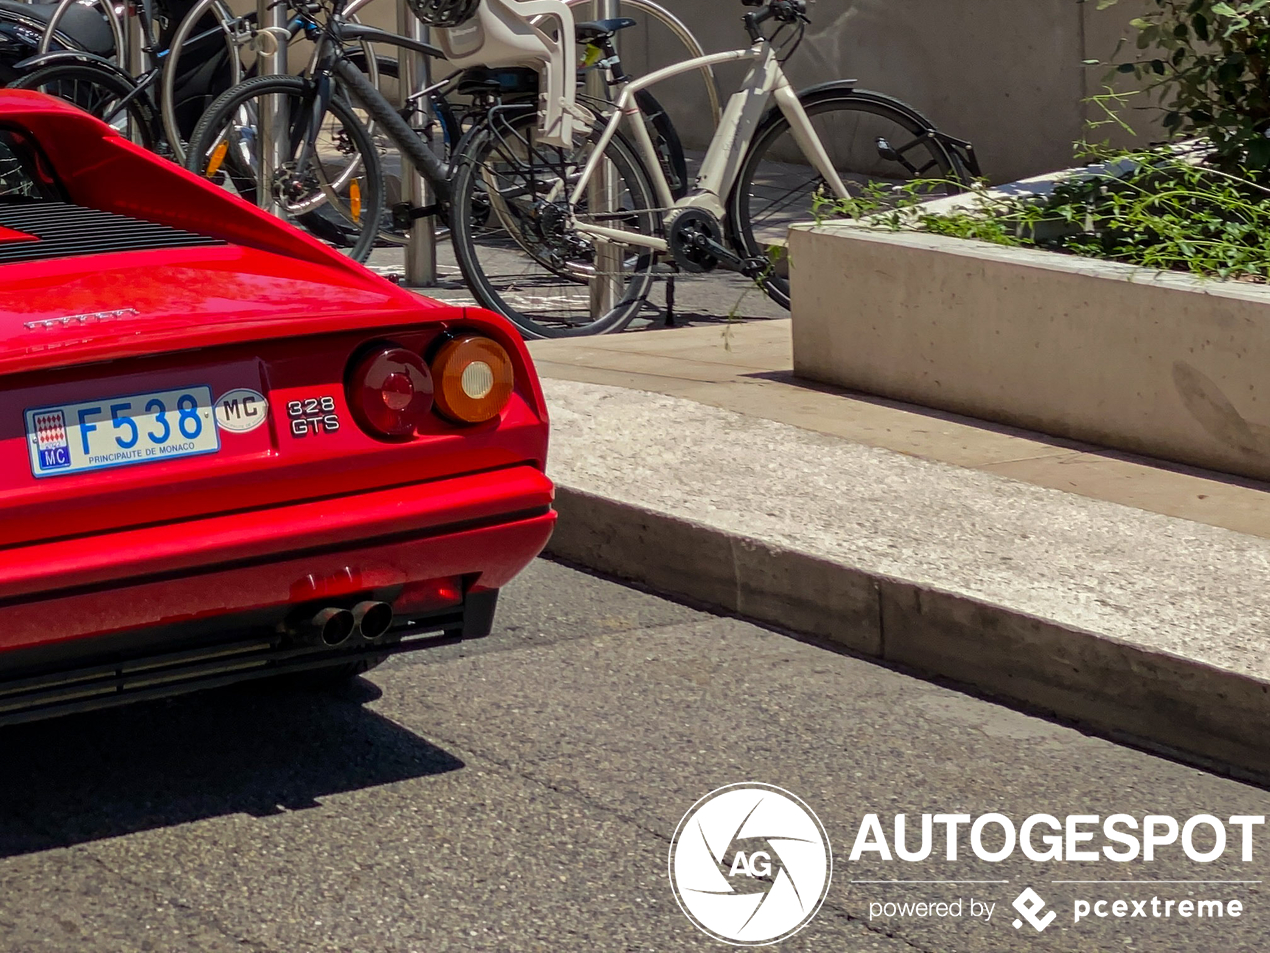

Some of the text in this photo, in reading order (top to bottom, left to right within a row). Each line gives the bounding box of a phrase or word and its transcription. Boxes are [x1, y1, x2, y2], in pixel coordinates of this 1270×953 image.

[223, 395, 258, 421] MC
[286, 395, 336, 416] 328
[291, 414, 340, 436] GTS
[44, 448, 66, 466] MC
[89, 441, 195, 464] PRINCIPAUTE DE MONACO
